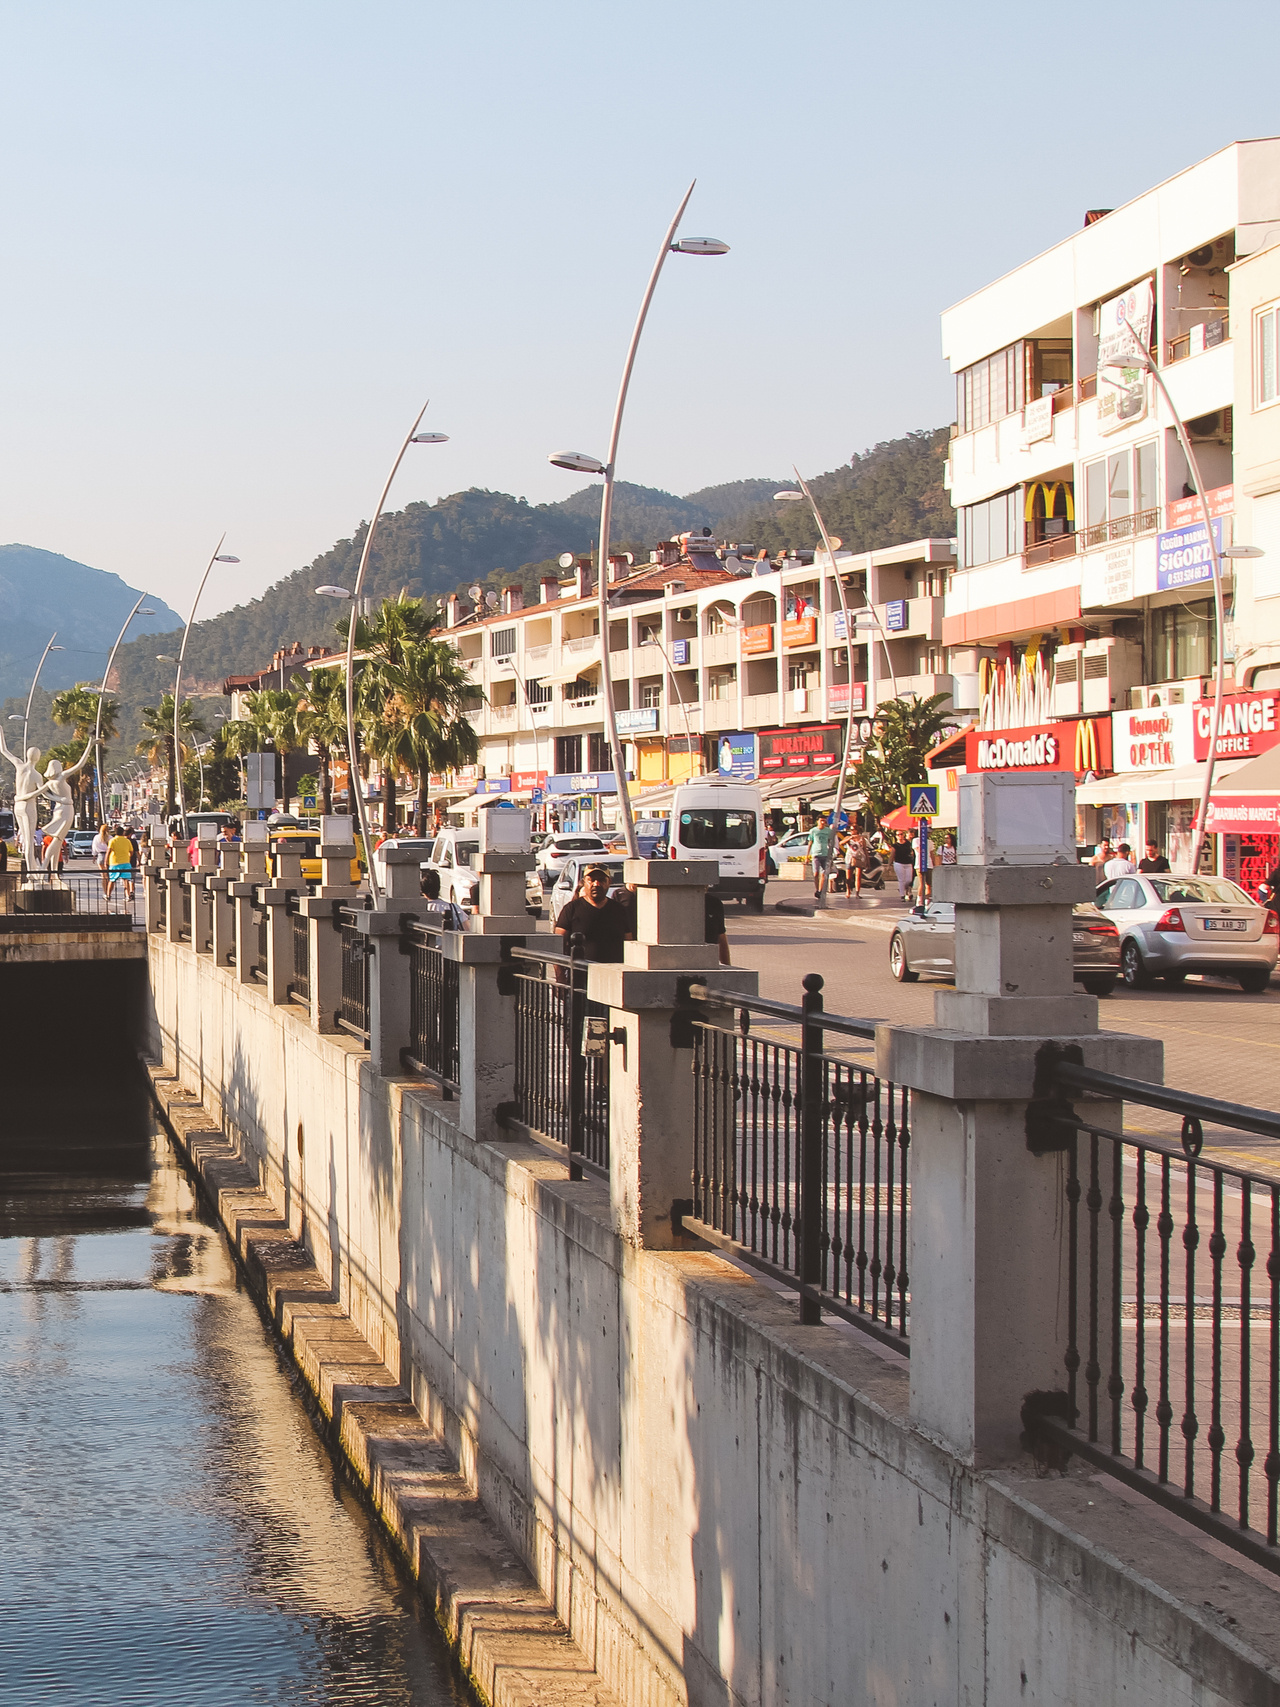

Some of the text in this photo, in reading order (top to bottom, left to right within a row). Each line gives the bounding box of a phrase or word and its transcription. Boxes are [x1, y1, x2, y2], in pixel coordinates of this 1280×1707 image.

[1160, 523, 1219, 552] ÖZGÜR MARMAS
[1158, 543, 1214, 572] SİGORT
[978, 733, 1058, 769] McDonald's
[1215, 736, 1251, 753] OFFICE
[533, 788, 541, 800] P
[1214, 804, 1277, 821] MARMARİS MARKET
[1209, 920, 1217, 928] 35
